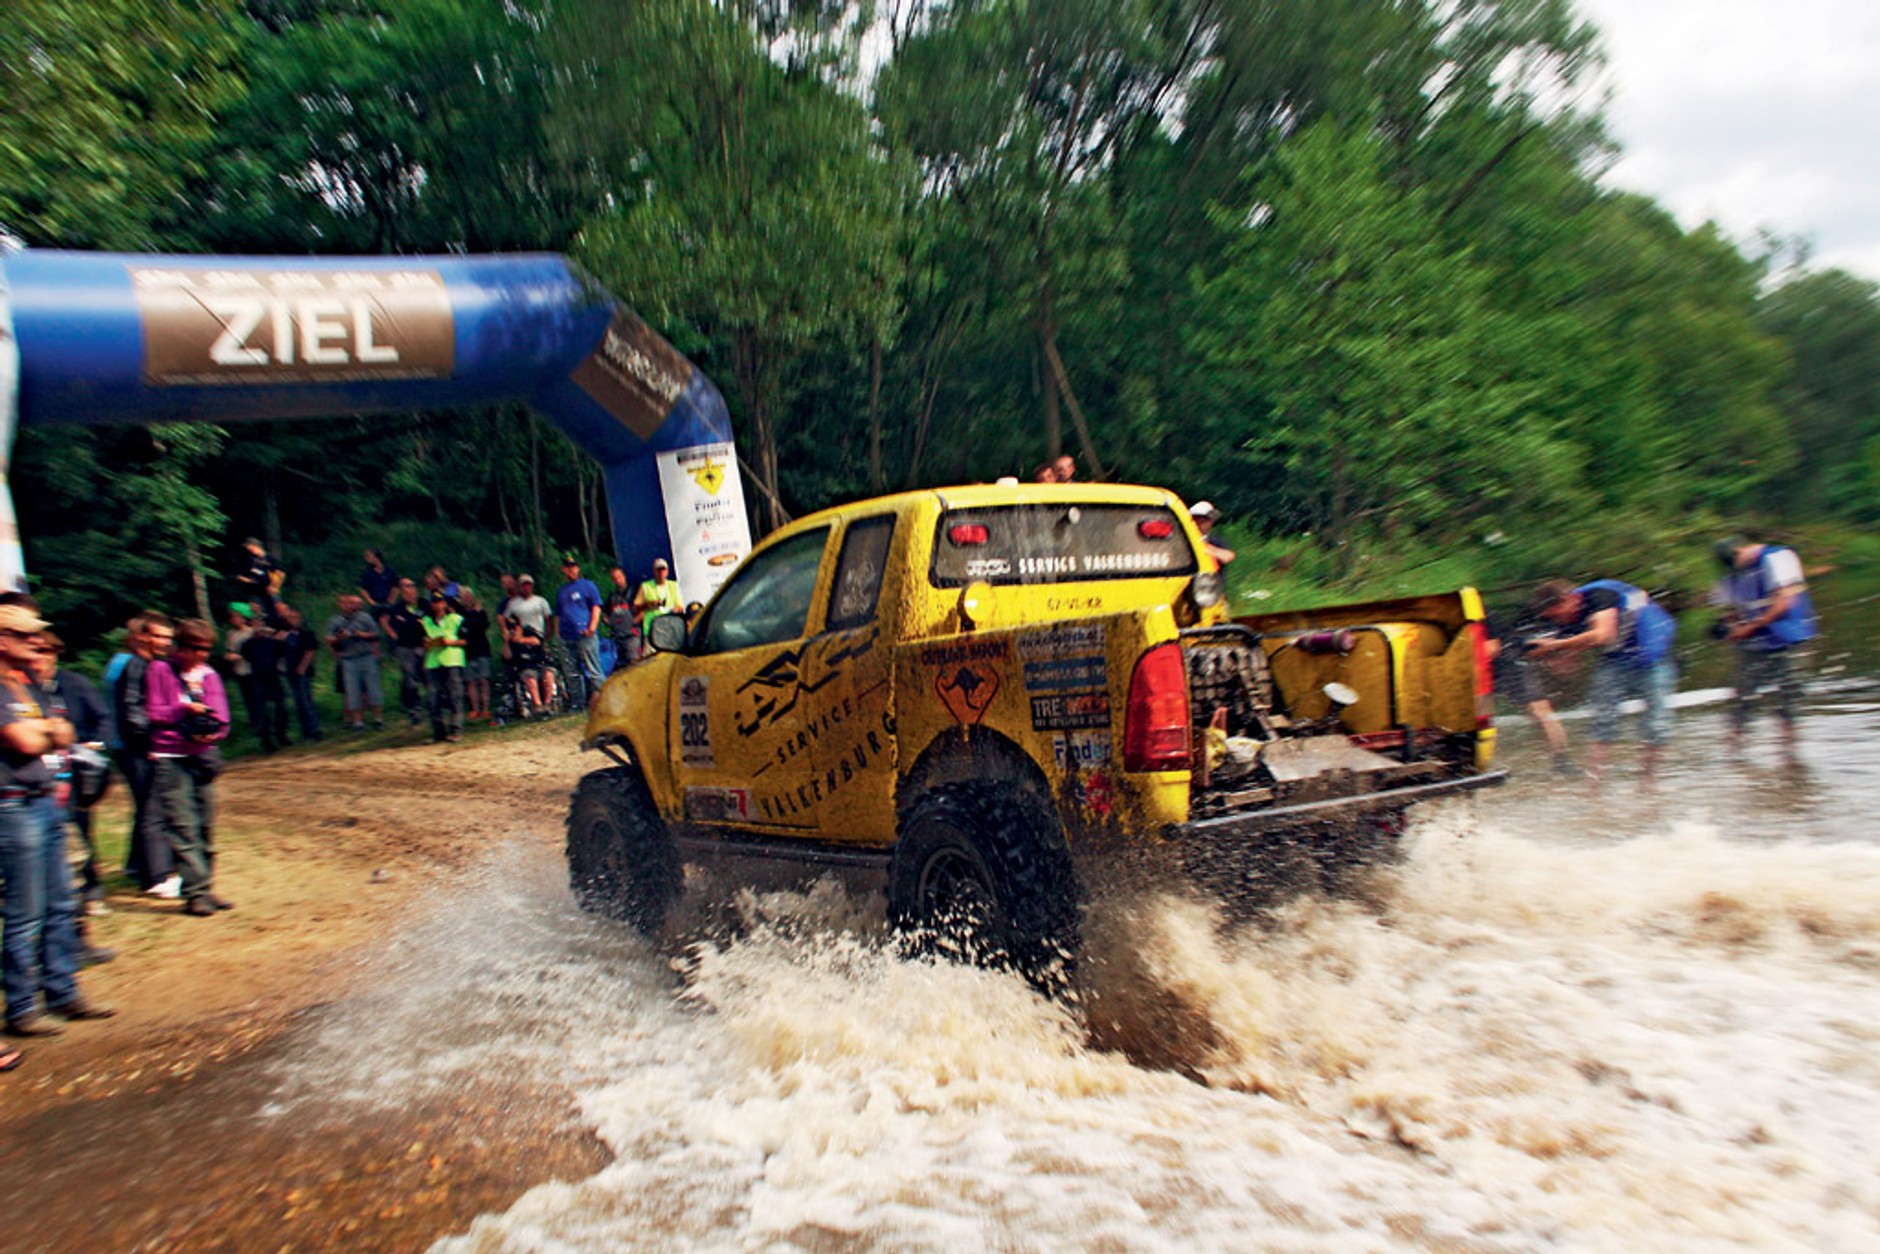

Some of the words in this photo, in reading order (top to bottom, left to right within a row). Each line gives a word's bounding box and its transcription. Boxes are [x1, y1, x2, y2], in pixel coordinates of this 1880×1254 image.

[209, 299, 400, 365] ZIEL
[1019, 556, 1076, 574] SERVICE
[1083, 552, 1170, 571] VALKENBURG
[680, 712, 710, 747] 202
[776, 697, 852, 764] SERVICE
[1054, 739, 1111, 760] Fnder
[760, 711, 898, 818] VALKENBURG
